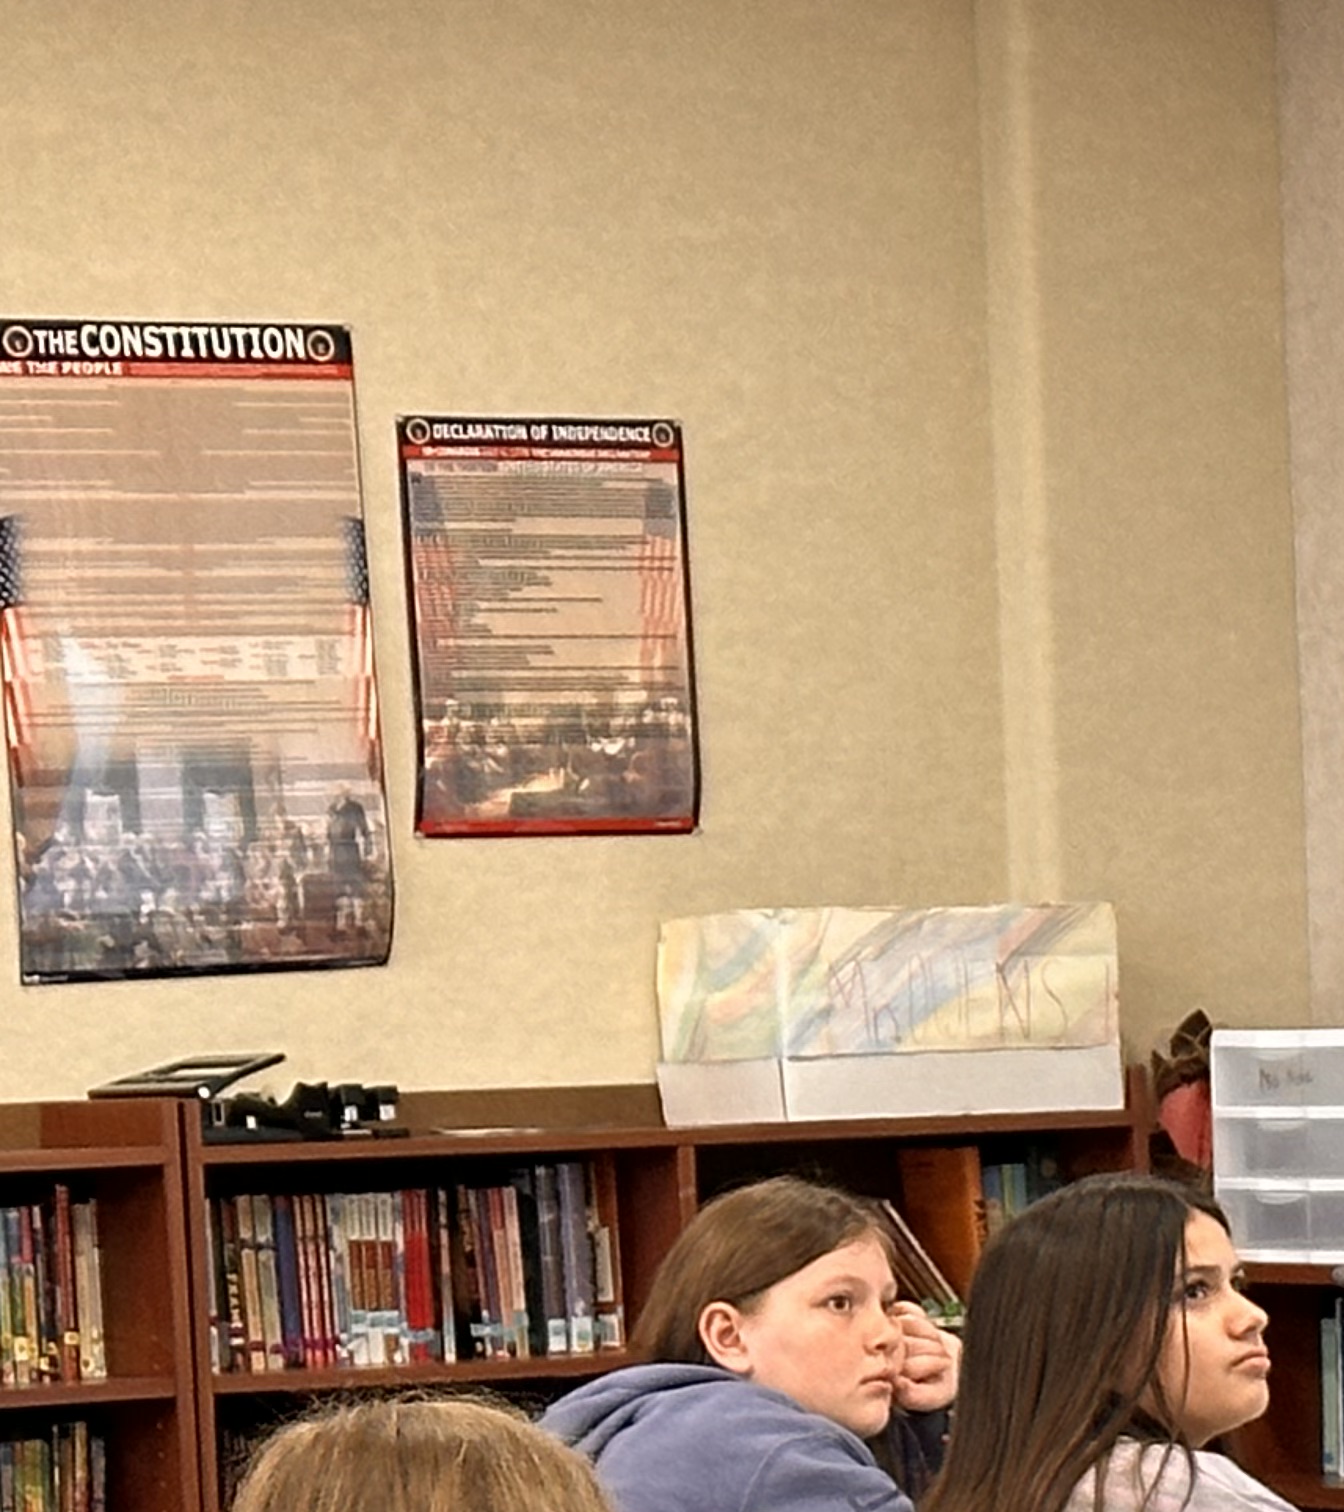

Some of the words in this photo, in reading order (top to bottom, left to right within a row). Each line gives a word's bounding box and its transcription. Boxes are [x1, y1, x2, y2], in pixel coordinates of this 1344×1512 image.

[33, 330, 78, 355] THE
[81, 325, 307, 359] CONSTITUTION
[61, 361, 123, 376] PEOPLE
[433, 423, 527, 440] DECLARATION
[530, 424, 548, 441] OF
[552, 425, 651, 442] INDEPENDENCE
